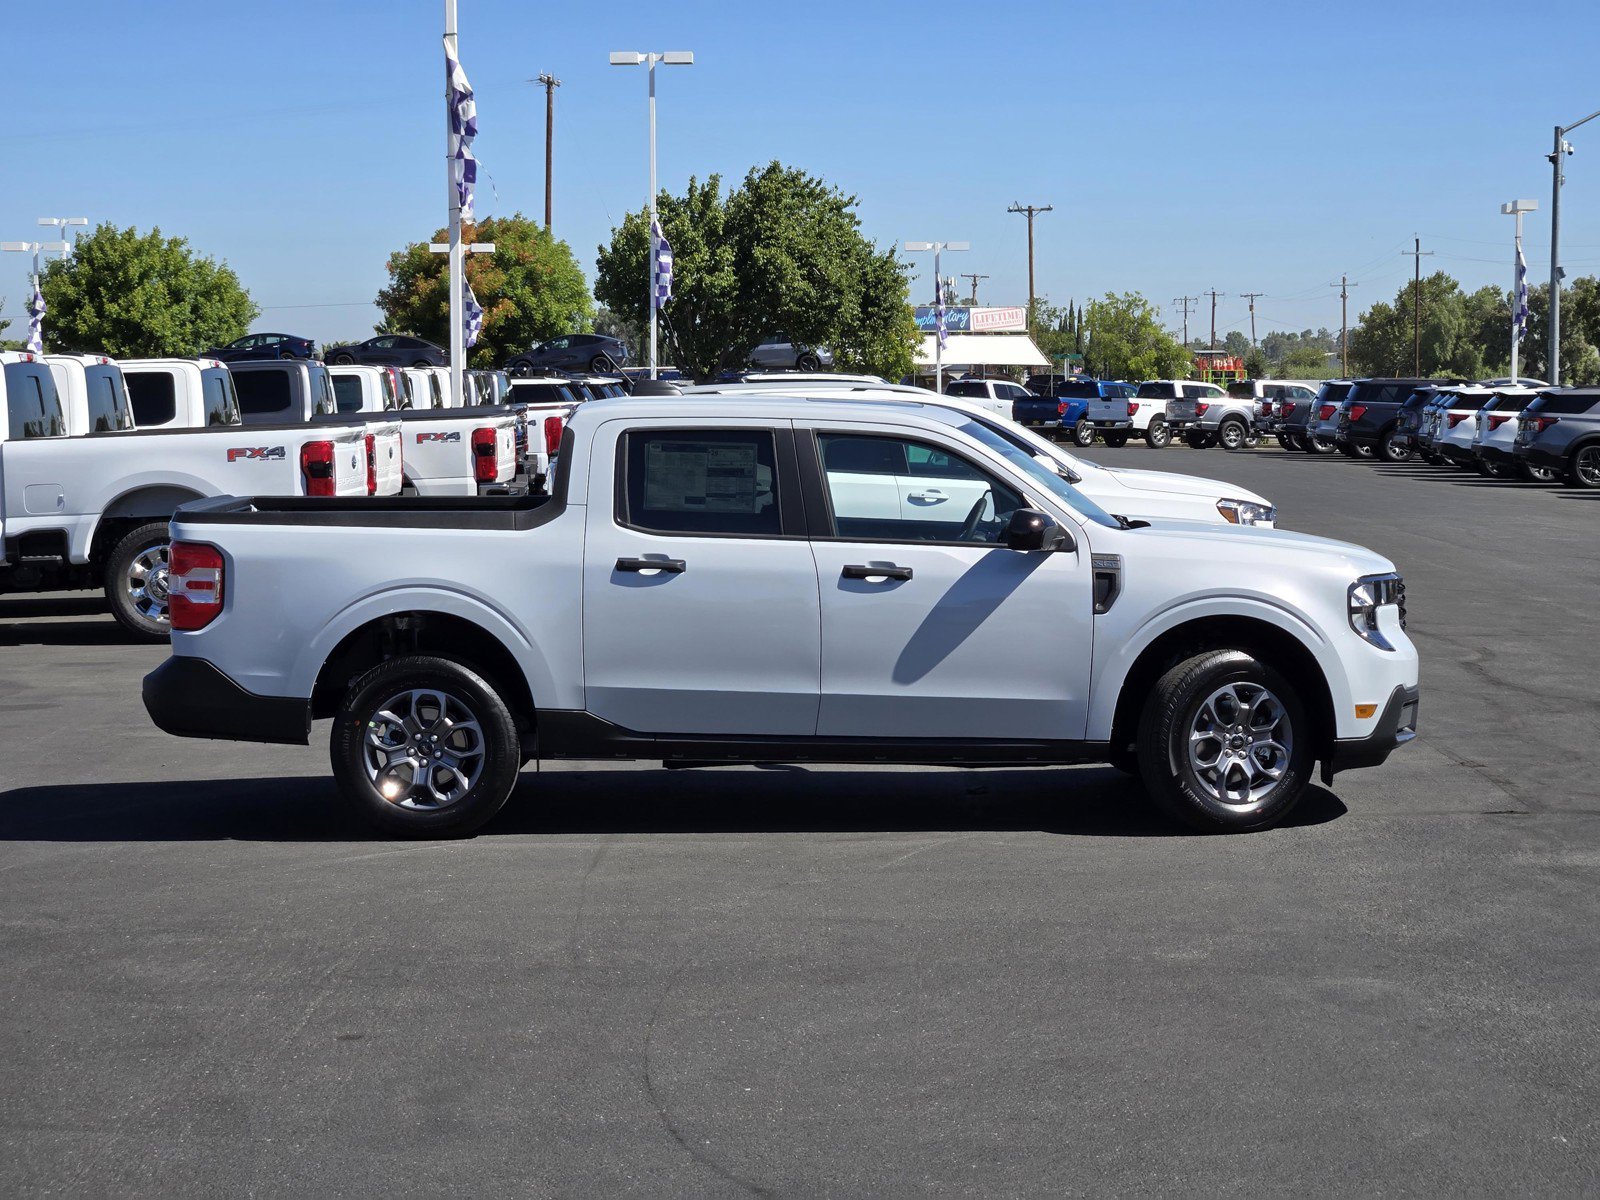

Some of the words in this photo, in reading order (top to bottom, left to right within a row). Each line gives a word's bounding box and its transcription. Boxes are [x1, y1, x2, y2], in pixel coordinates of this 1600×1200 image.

[975, 310, 1021, 324] LIFETIME
[416, 432, 461, 444] FX4
[227, 446, 286, 462] FX4
